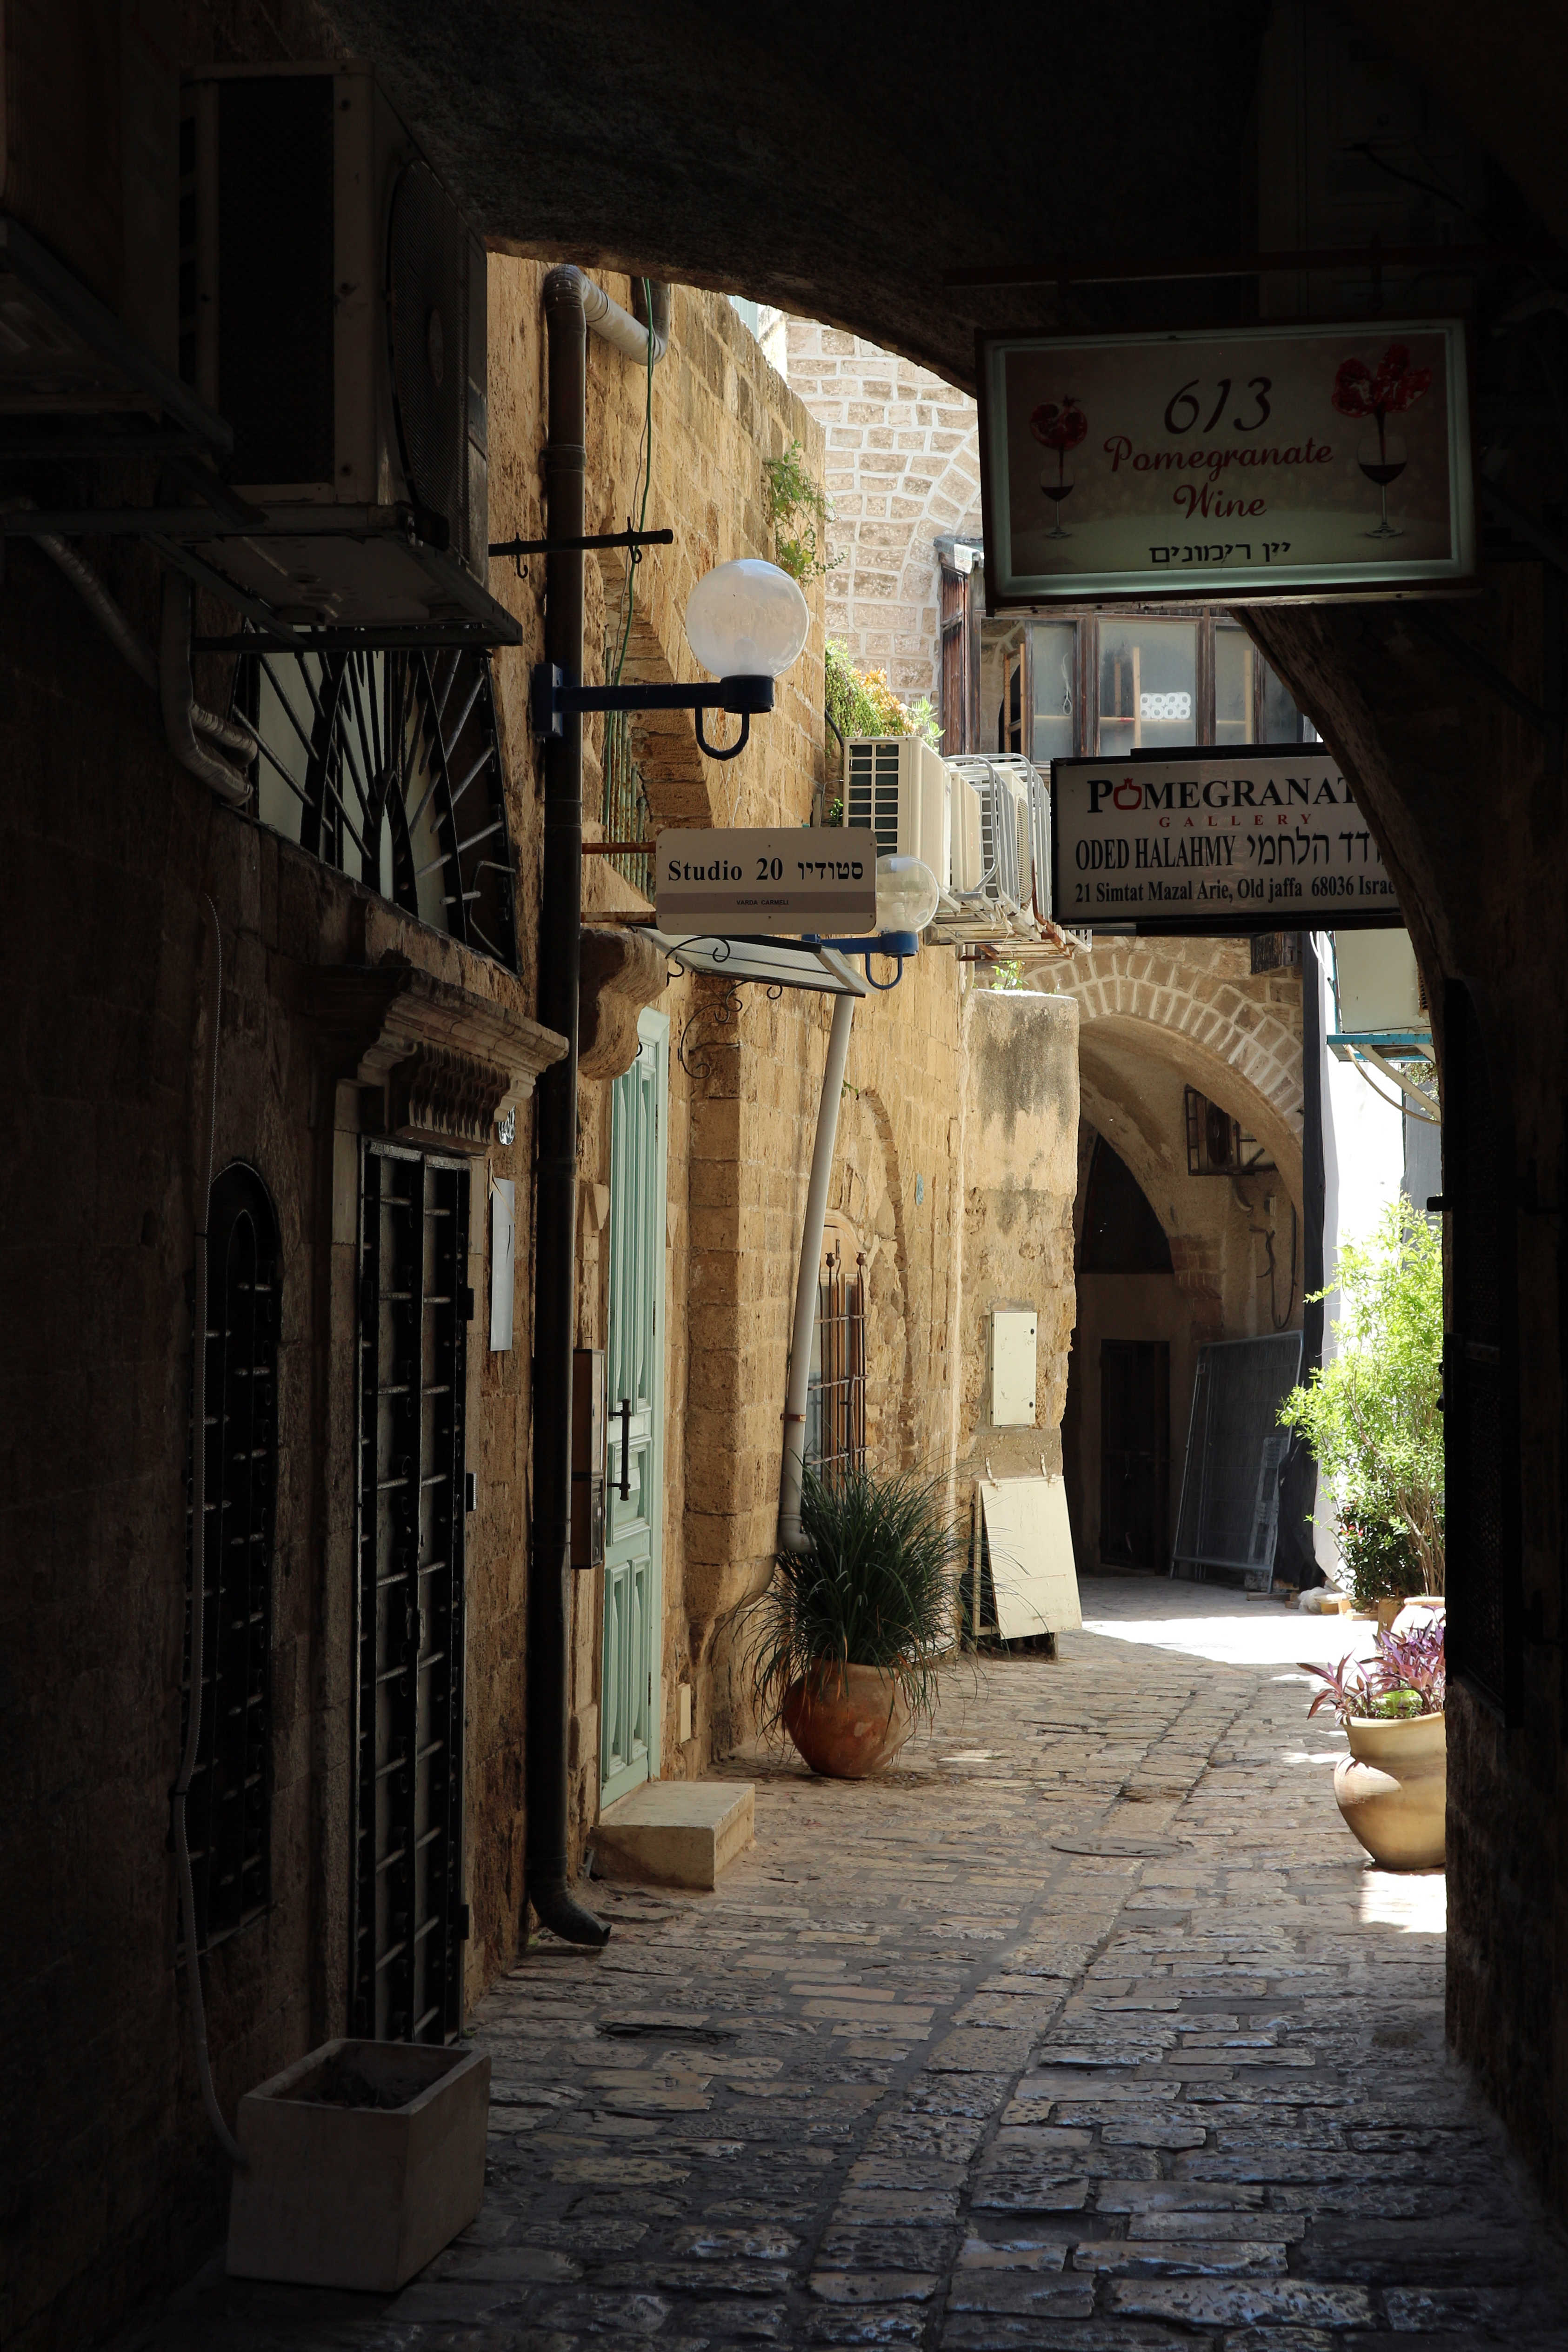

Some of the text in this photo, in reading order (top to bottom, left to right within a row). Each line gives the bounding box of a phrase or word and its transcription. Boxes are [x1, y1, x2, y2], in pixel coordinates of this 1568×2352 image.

[1164, 376, 1272, 434] 613
[1103, 434, 1334, 481] Pomegranate
[1173, 482, 1267, 520] Wine
[1148, 541, 1291, 563] יין רימונים
[1087, 777, 1357, 813] POMEGRANAT
[1159, 814, 1312, 828] GALLERY
[1075, 835, 1236, 870] ODED HALAHMY
[1247, 826, 1329, 866] הלחמי
[668, 857, 783, 881] Studio 20
[798, 862, 863, 880] סטודיו
[1075, 875, 1395, 903] 21 Simtat Mazal Arie, Old jaffa 68036 Israe
